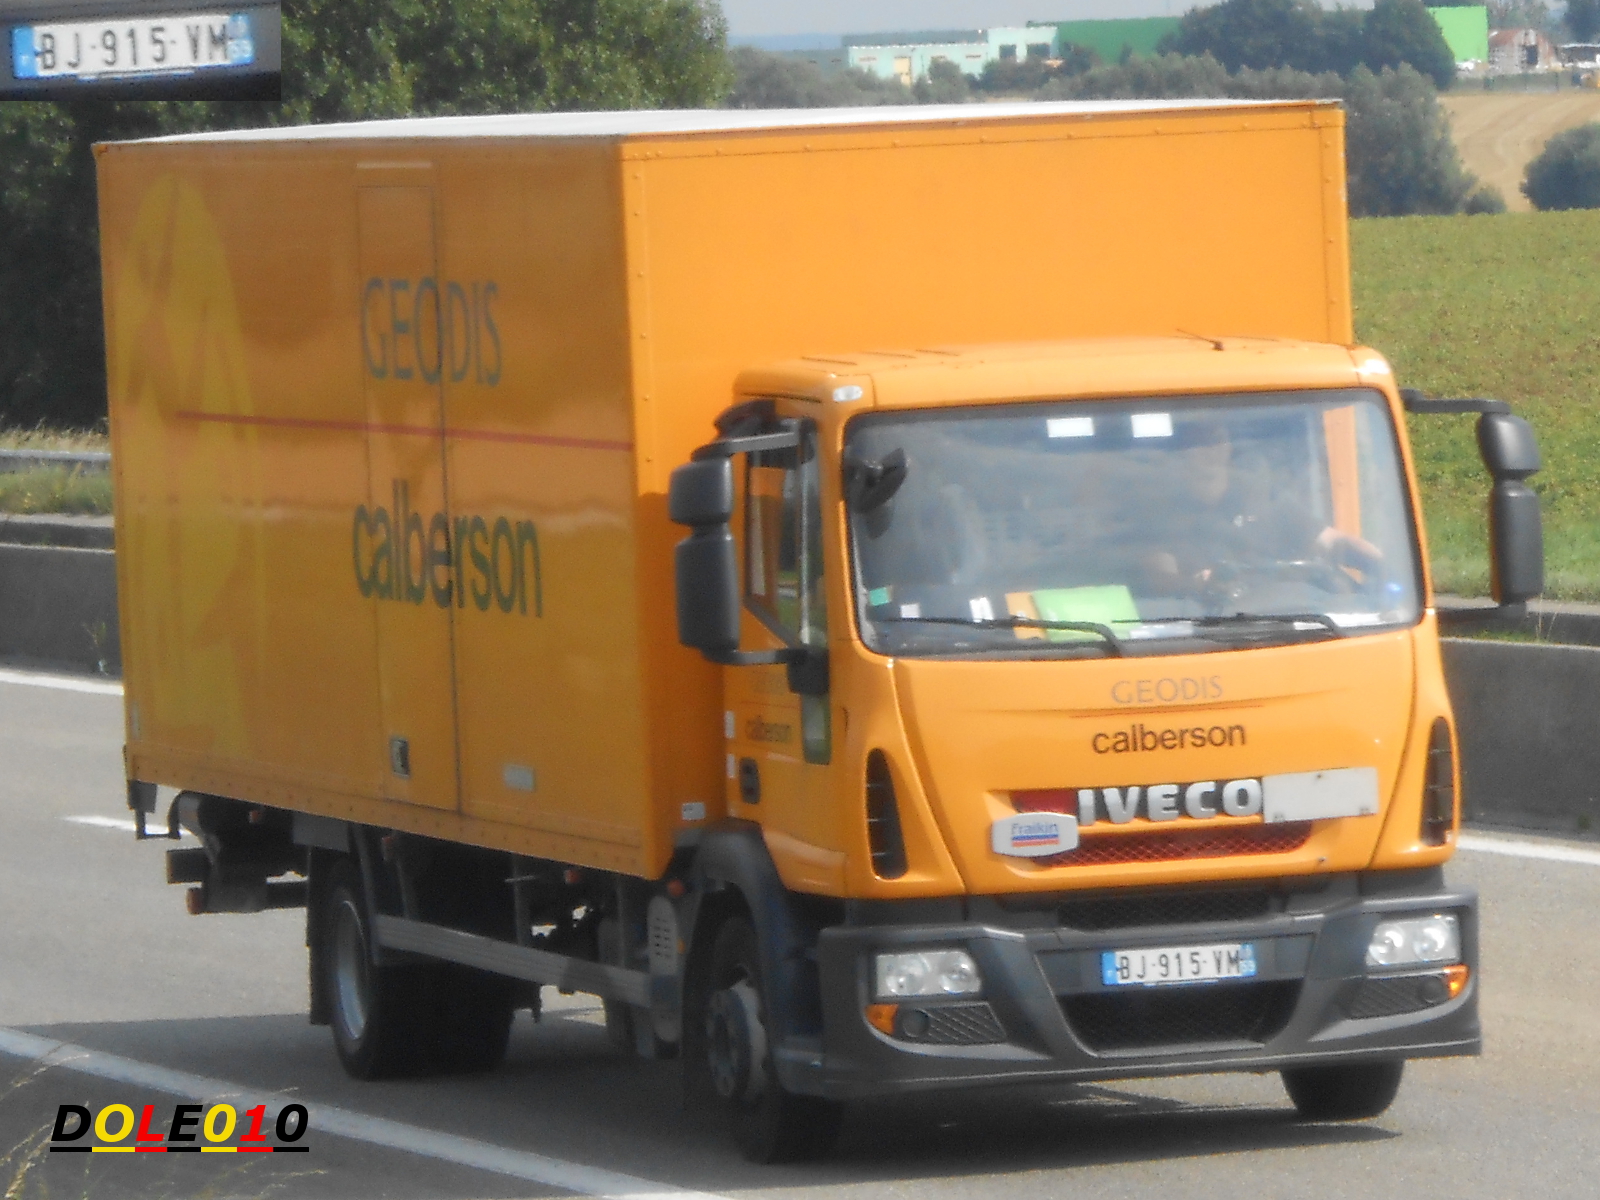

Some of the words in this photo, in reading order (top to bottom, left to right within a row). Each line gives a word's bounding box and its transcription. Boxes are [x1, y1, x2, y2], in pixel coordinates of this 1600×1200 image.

[361, 277, 501, 387] GEODIS
[353, 478, 544, 618] calberson
[1111, 675, 1223, 705] GEODIS
[1092, 723, 1247, 754] calberson
[1078, 778, 1263, 826] IVECO
